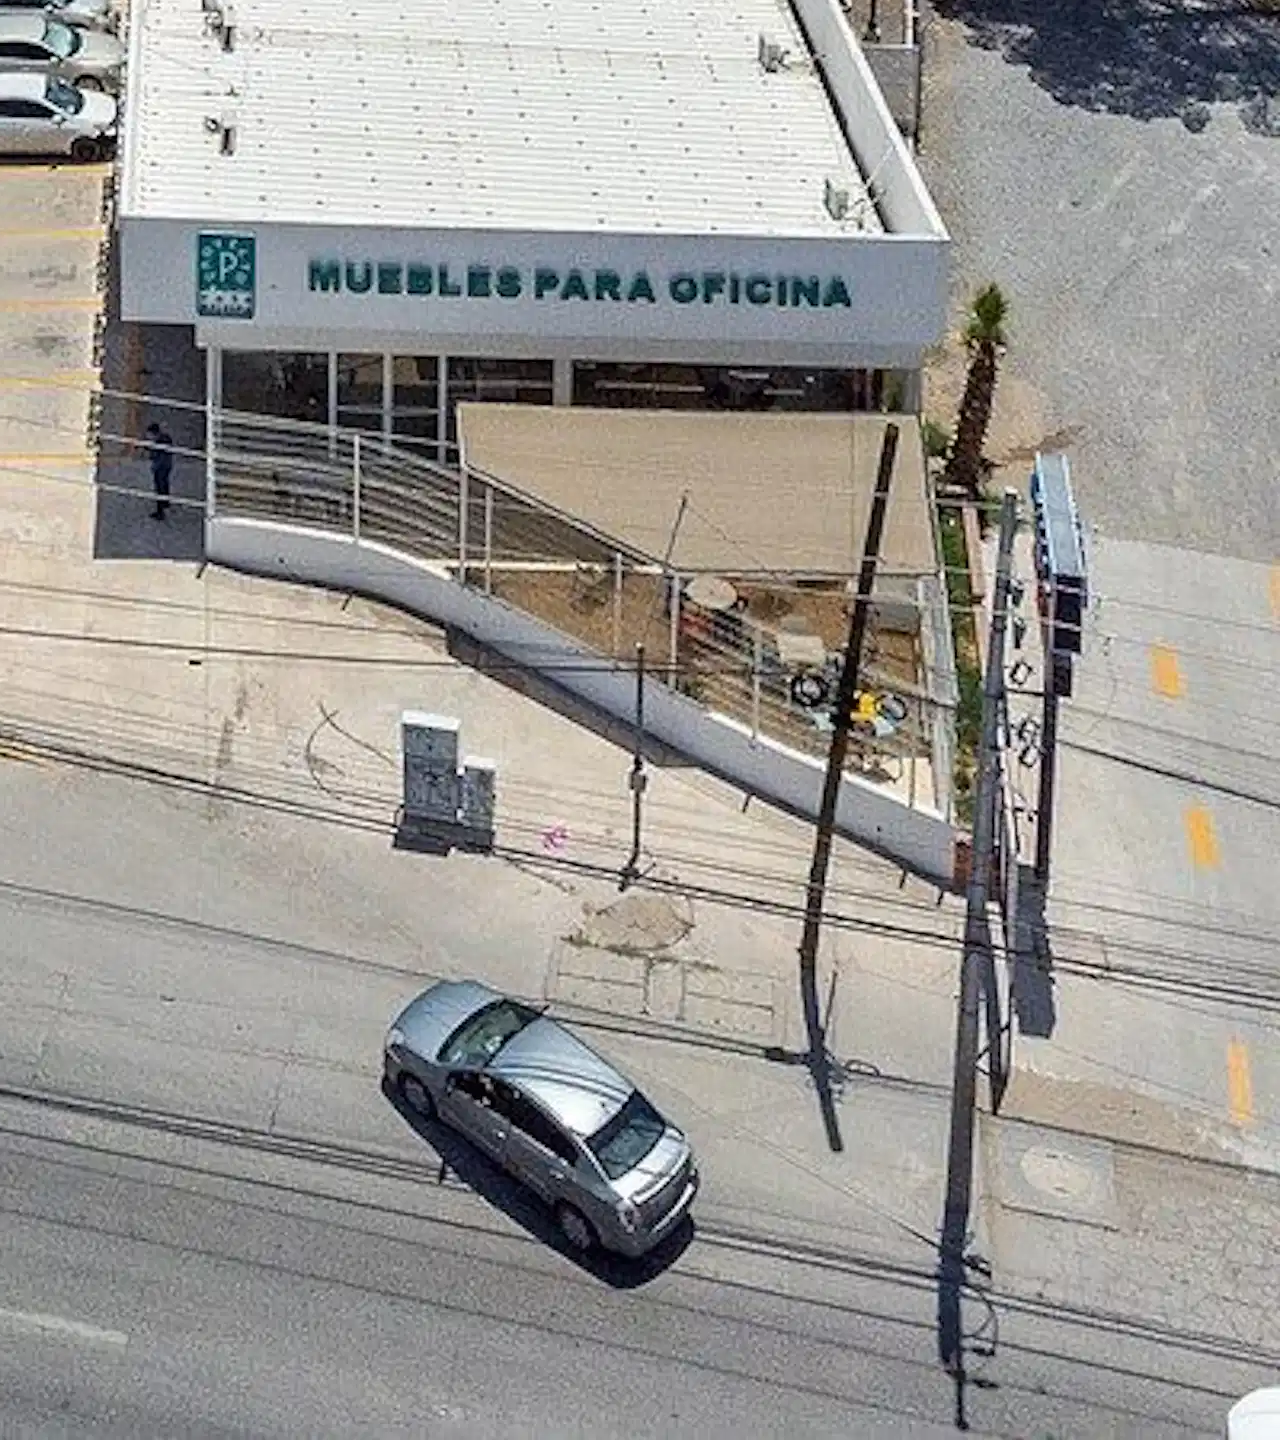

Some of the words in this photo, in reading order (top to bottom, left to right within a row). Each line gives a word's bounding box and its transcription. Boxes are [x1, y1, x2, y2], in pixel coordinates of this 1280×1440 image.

[308, 259, 523, 299] MUEBLES
[534, 263, 656, 303] PARA
[668, 271, 852, 309] OFICINA
